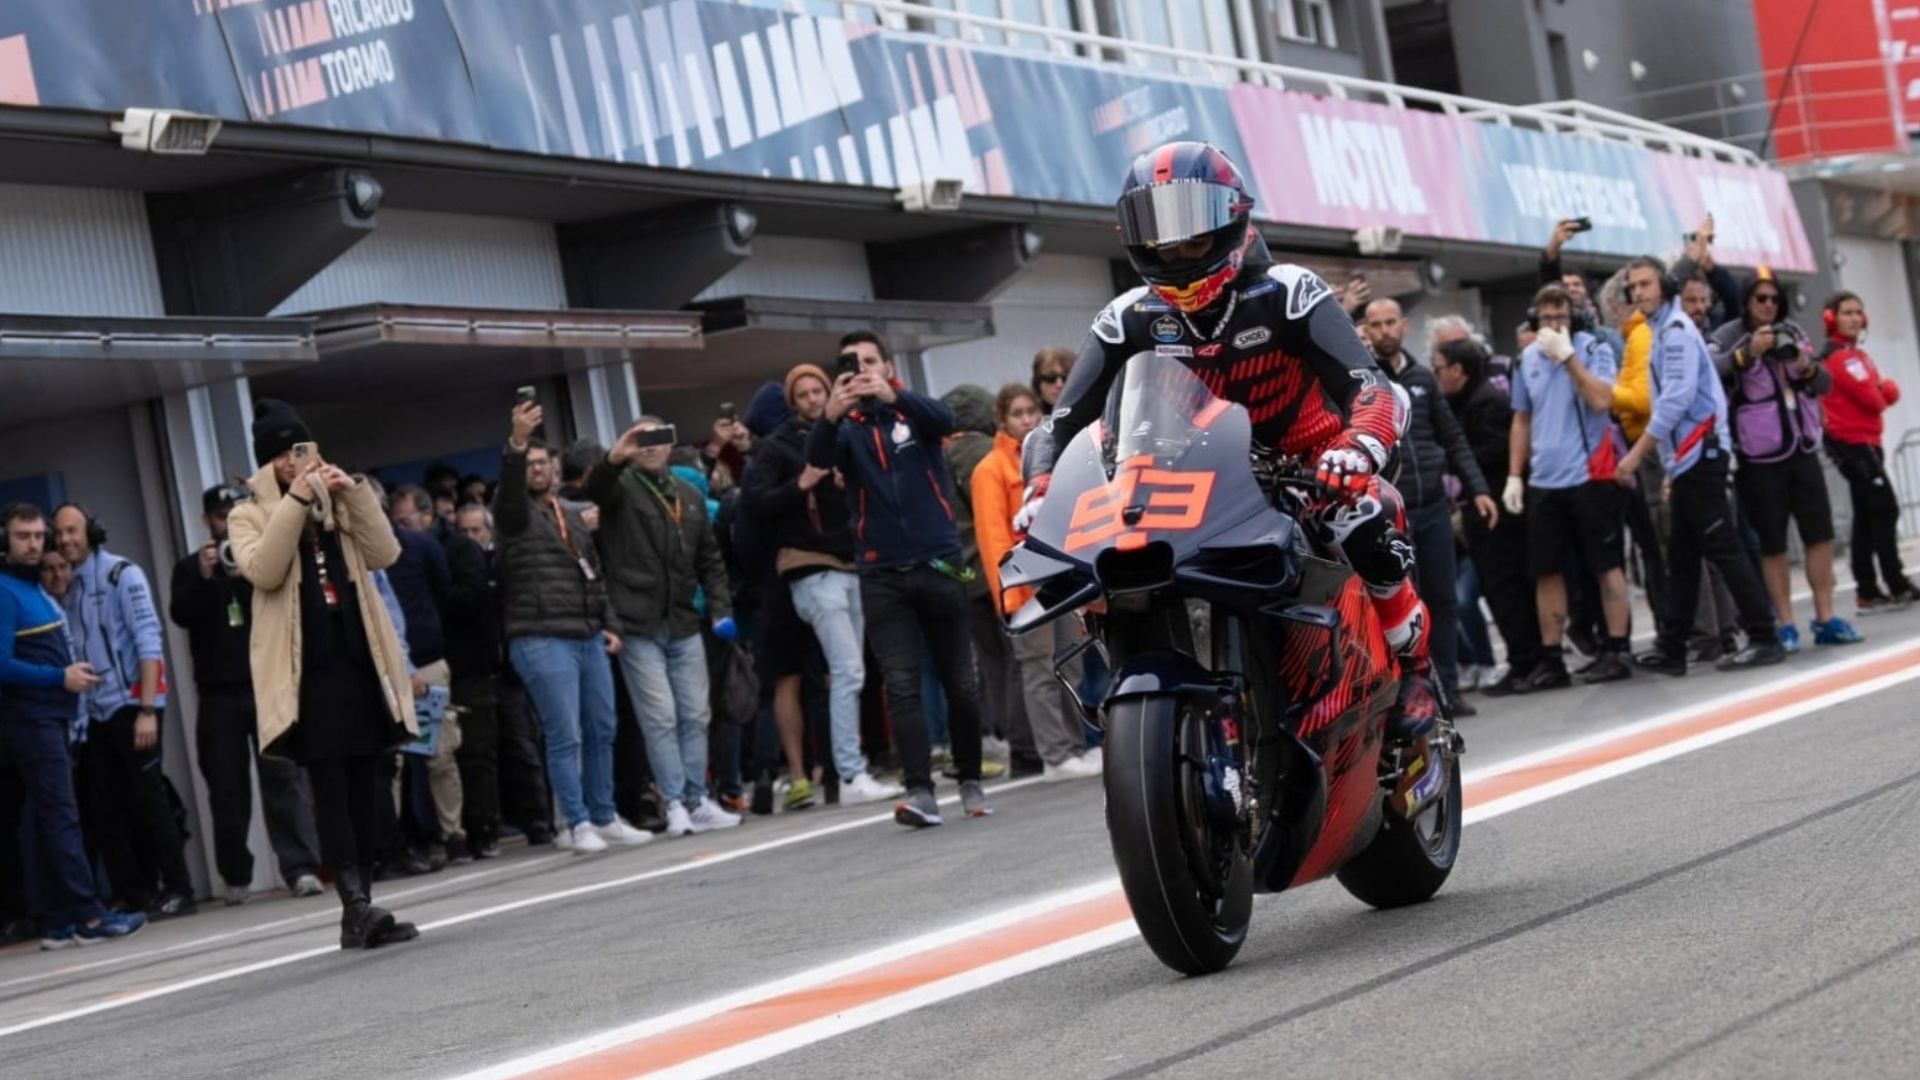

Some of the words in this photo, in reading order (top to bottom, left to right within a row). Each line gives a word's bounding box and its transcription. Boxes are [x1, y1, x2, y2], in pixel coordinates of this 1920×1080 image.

[320, 39, 395, 97] TORMO
[1298, 112, 1427, 214] MOTUL
[1238, 329, 1267, 345] SHOEI
[1064, 455, 1217, 553] 93
